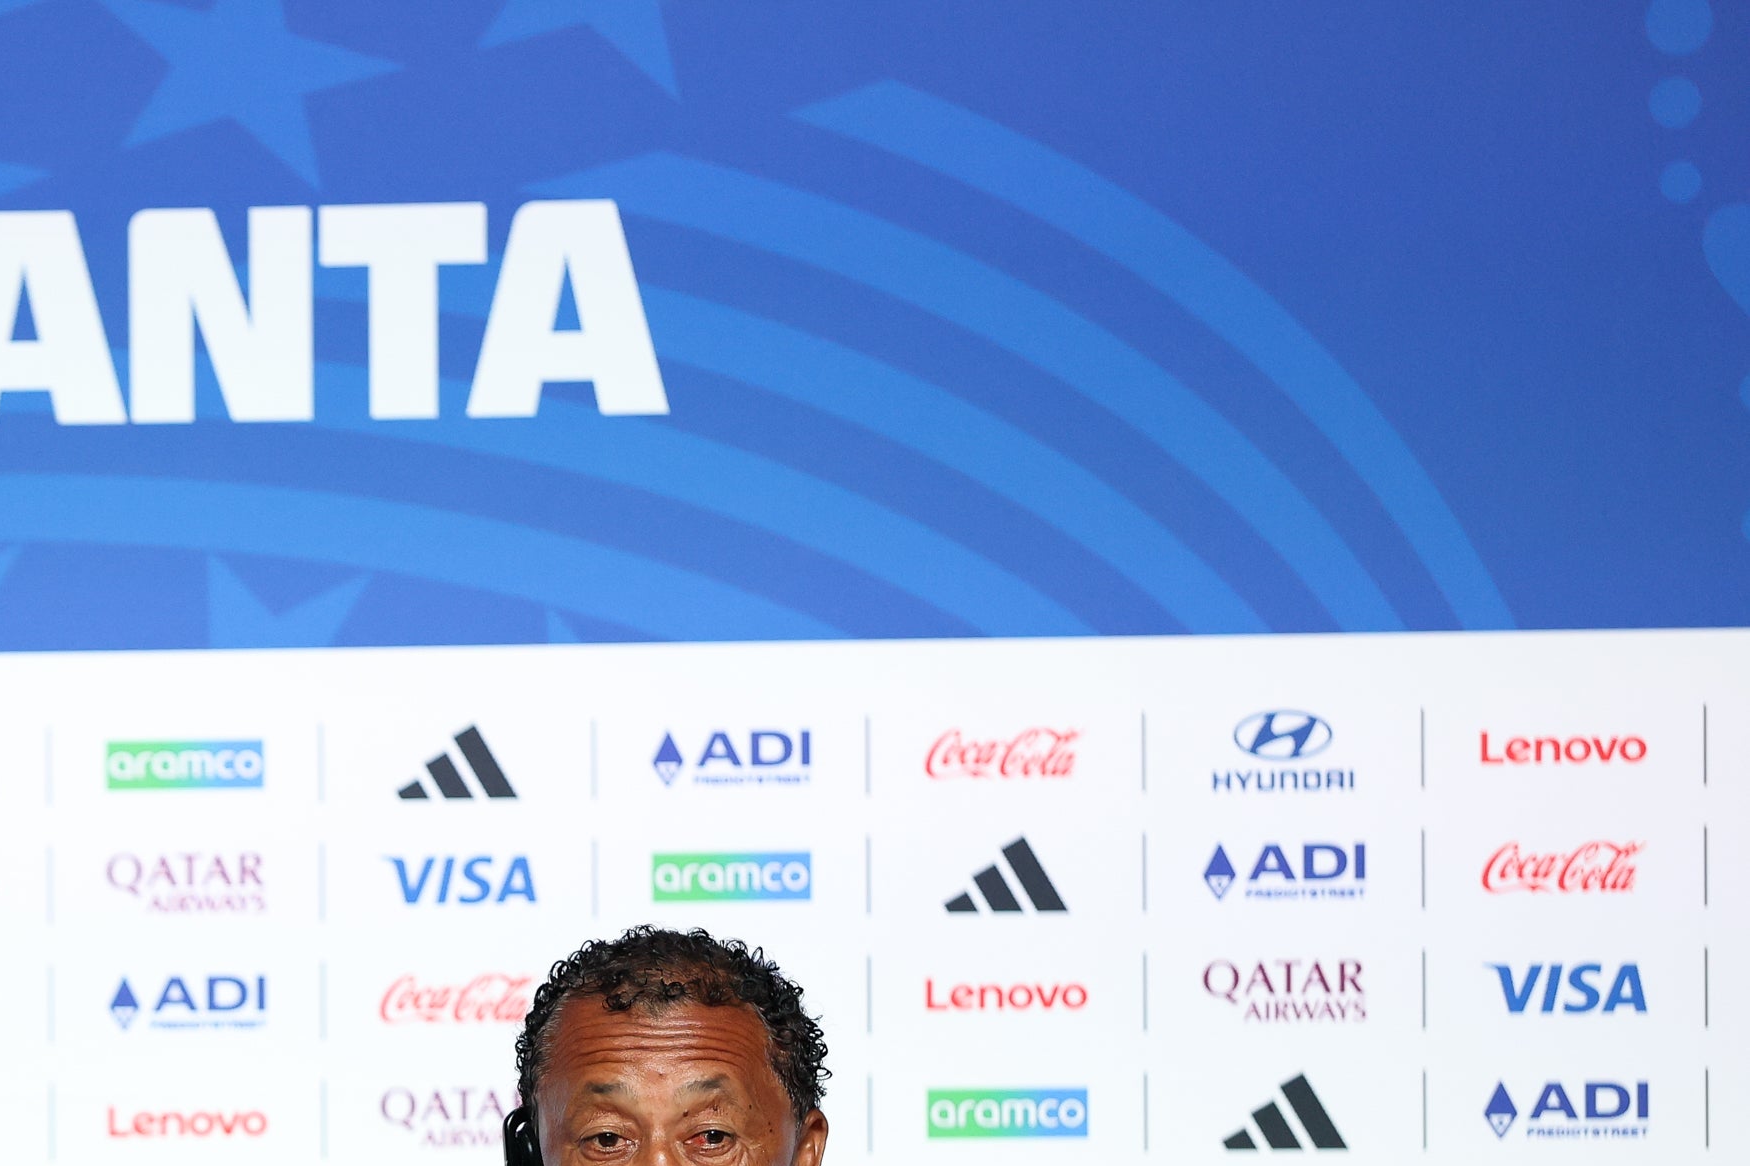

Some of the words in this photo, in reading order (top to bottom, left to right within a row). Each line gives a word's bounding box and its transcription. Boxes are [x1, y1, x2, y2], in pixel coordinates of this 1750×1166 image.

[110, 746, 262, 781] aramco
[697, 730, 811, 768] ADI
[1481, 732, 1647, 763] Lenovo
[1213, 771, 1354, 791] HYUNDAI
[106, 854, 264, 894] QATAR
[655, 860, 808, 892] aramco
[1249, 843, 1365, 881] ADI
[390, 856, 537, 905] VISA
[154, 976, 266, 1012] ADI
[926, 979, 1088, 1010] Lenovo
[1203, 959, 1365, 1000] QATAR
[1492, 963, 1647, 1014] VISA
[1245, 1001, 1367, 1023] AIRWAYS
[930, 1098, 1086, 1129] aramco
[1530, 1082, 1649, 1120] ADI
[107, 1107, 268, 1138] Lenovo
